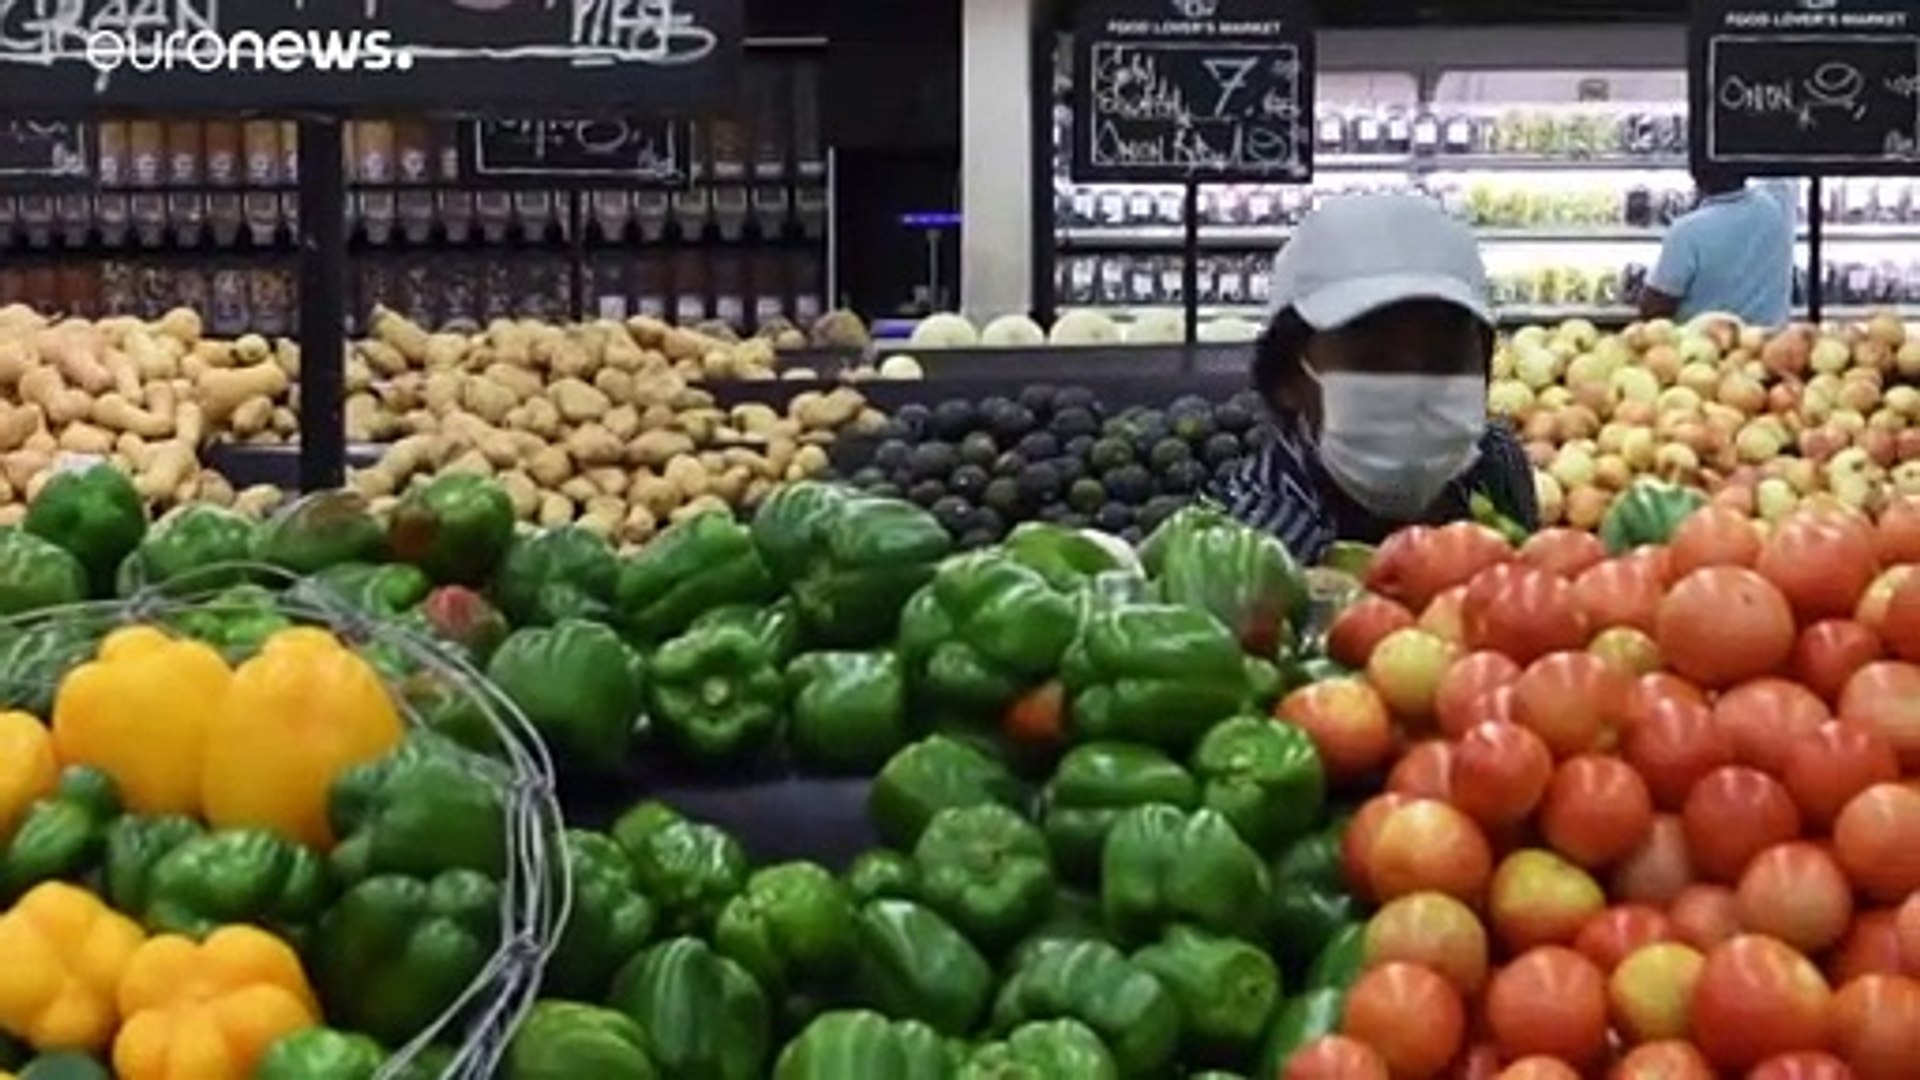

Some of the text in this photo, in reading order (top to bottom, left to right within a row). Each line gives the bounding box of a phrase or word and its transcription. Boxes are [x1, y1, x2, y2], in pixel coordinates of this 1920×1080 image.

[1725, 12, 1907, 26] FOOD LOVER'S MARKET
[1106, 20, 1281, 34] FOOD LOVER'S MARKET
